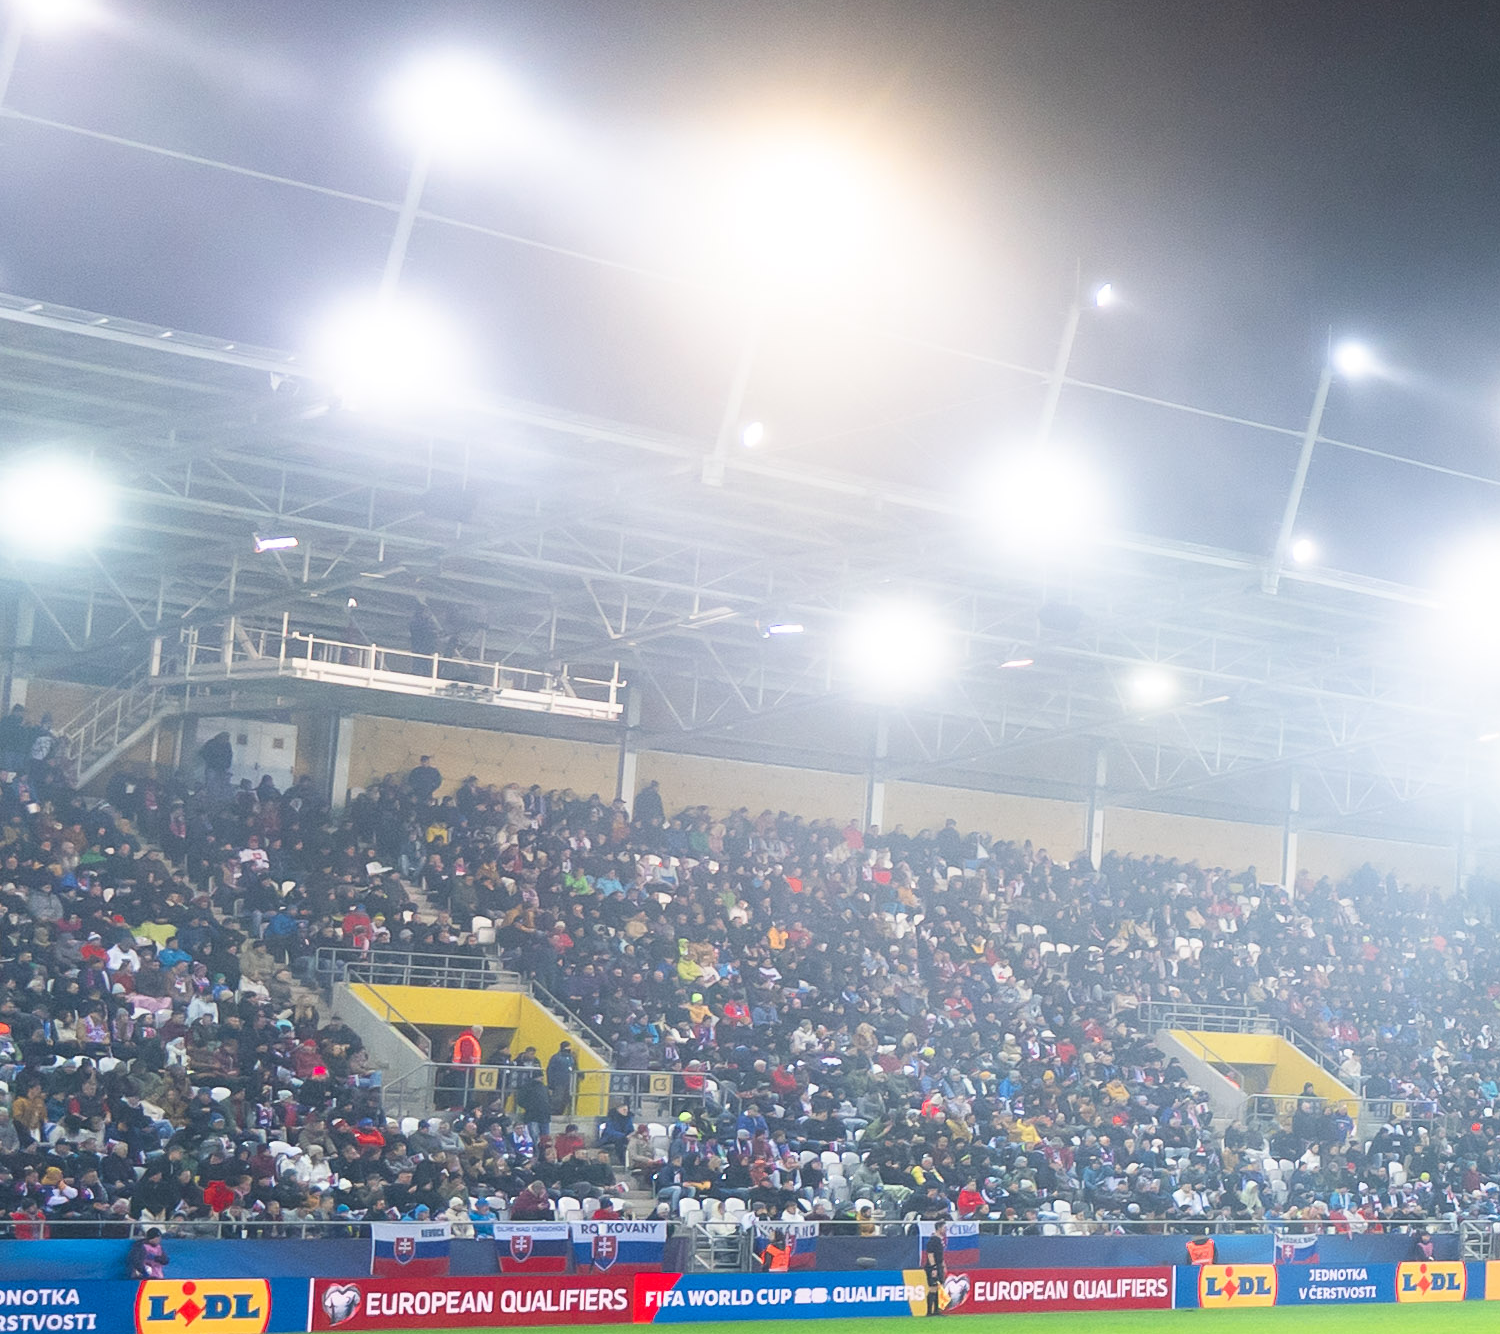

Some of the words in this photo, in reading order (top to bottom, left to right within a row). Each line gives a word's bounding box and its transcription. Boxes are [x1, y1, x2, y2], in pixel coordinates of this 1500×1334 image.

[479, 1071, 494, 1086] C4
[653, 1078, 666, 1091] C3
[580, 1223, 658, 1234] ROKOVANY
[1309, 1269, 1368, 1282] JEDNOTKA
[645, 1287, 684, 1307] FIFA
[688, 1287, 754, 1306] WORLD
[756, 1287, 792, 1305] CUP
[833, 1285, 925, 1302] QUALIFIERS
[974, 1280, 1068, 1301] EUROPEAN
[1073, 1278, 1169, 1300] QUALIFIERS
[1299, 1287, 1308, 1299] V
[1309, 1285, 1377, 1299] ČERSTVOSTI
[366, 1290, 494, 1316] EUROPEAN
[500, 1288, 628, 1314] QUALIFIERS
